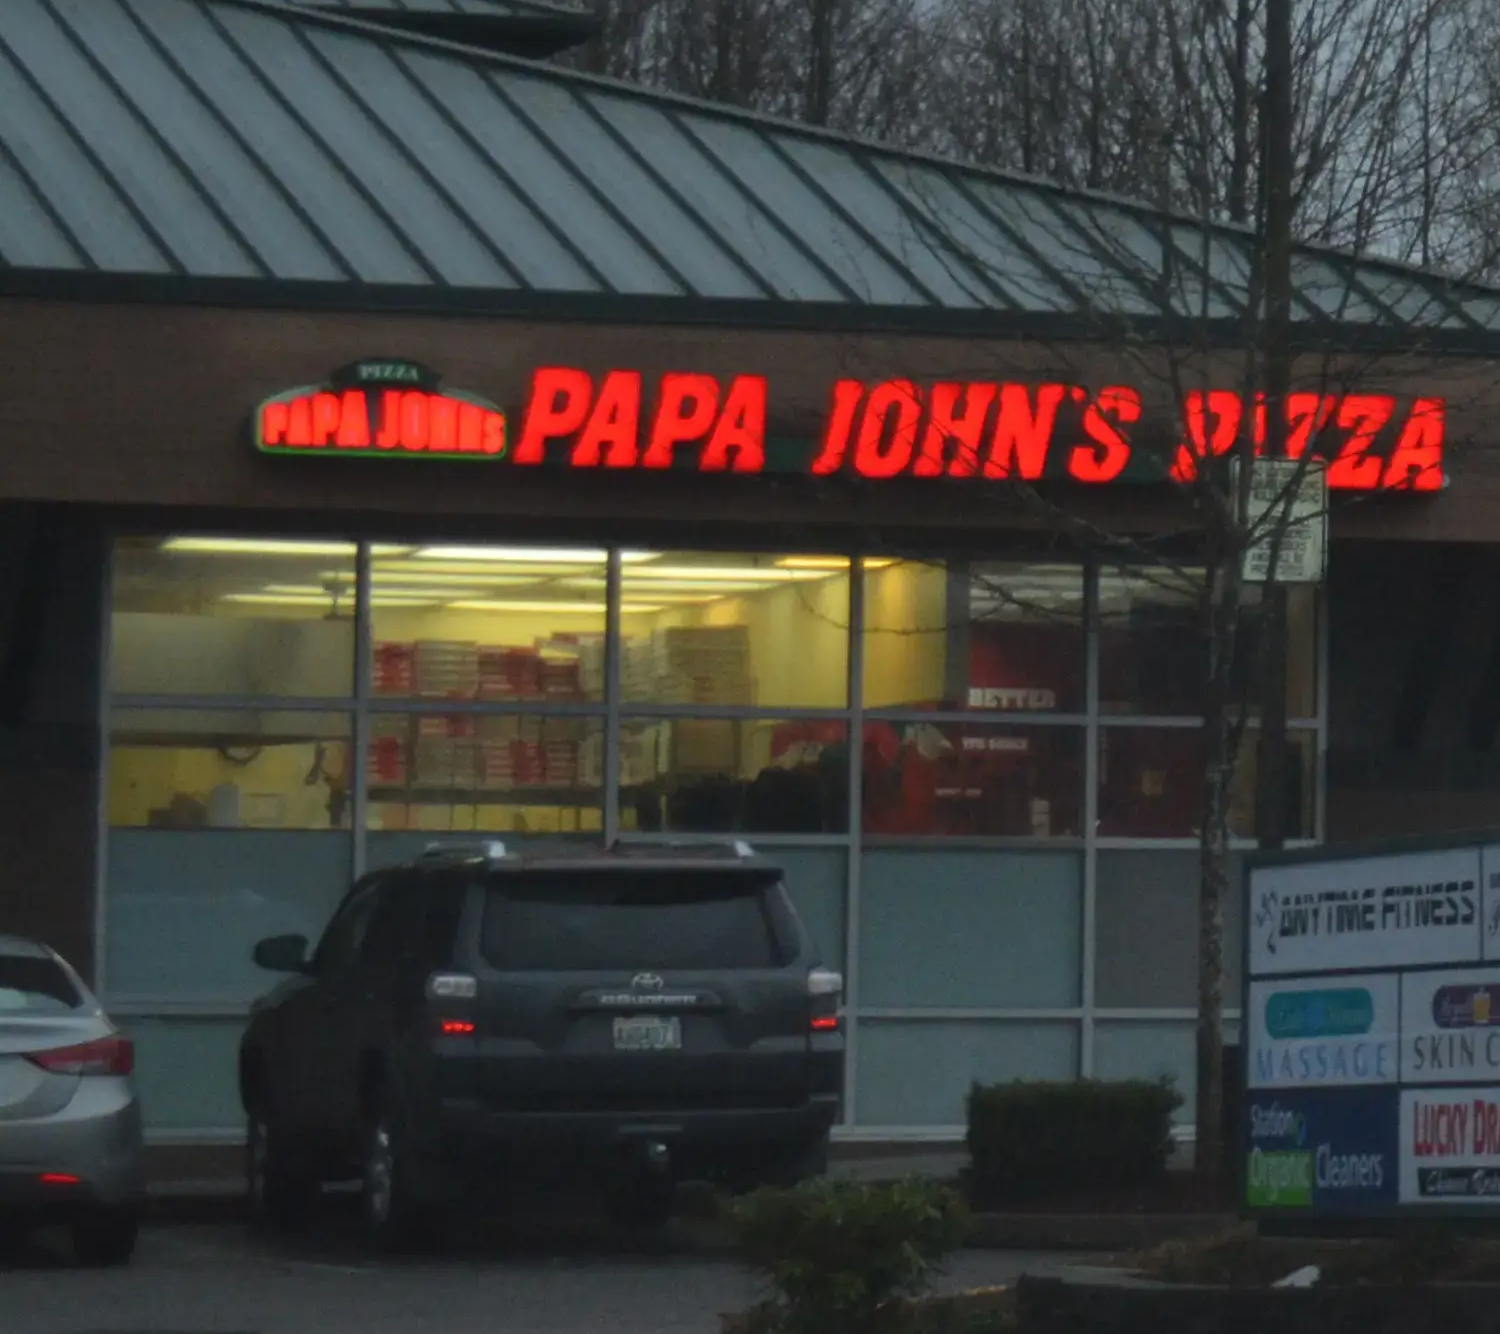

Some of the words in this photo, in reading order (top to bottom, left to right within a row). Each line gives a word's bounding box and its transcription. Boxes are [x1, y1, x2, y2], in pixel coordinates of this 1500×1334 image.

[357, 364, 419, 380] PIZZA
[262, 389, 371, 447] PAPA
[512, 365, 769, 472] PAPA
[810, 378, 1142, 483] JOHN'S
[1279, 888, 1376, 937] ANYTIME
[1382, 880, 1475, 930] FITNESS
[1255, 1044, 1387, 1082] MASSAGE
[1413, 1034, 1475, 1070] SKIN
[1413, 1101, 1468, 1157] LUCKY
[1316, 1142, 1384, 1189] Cleaners
